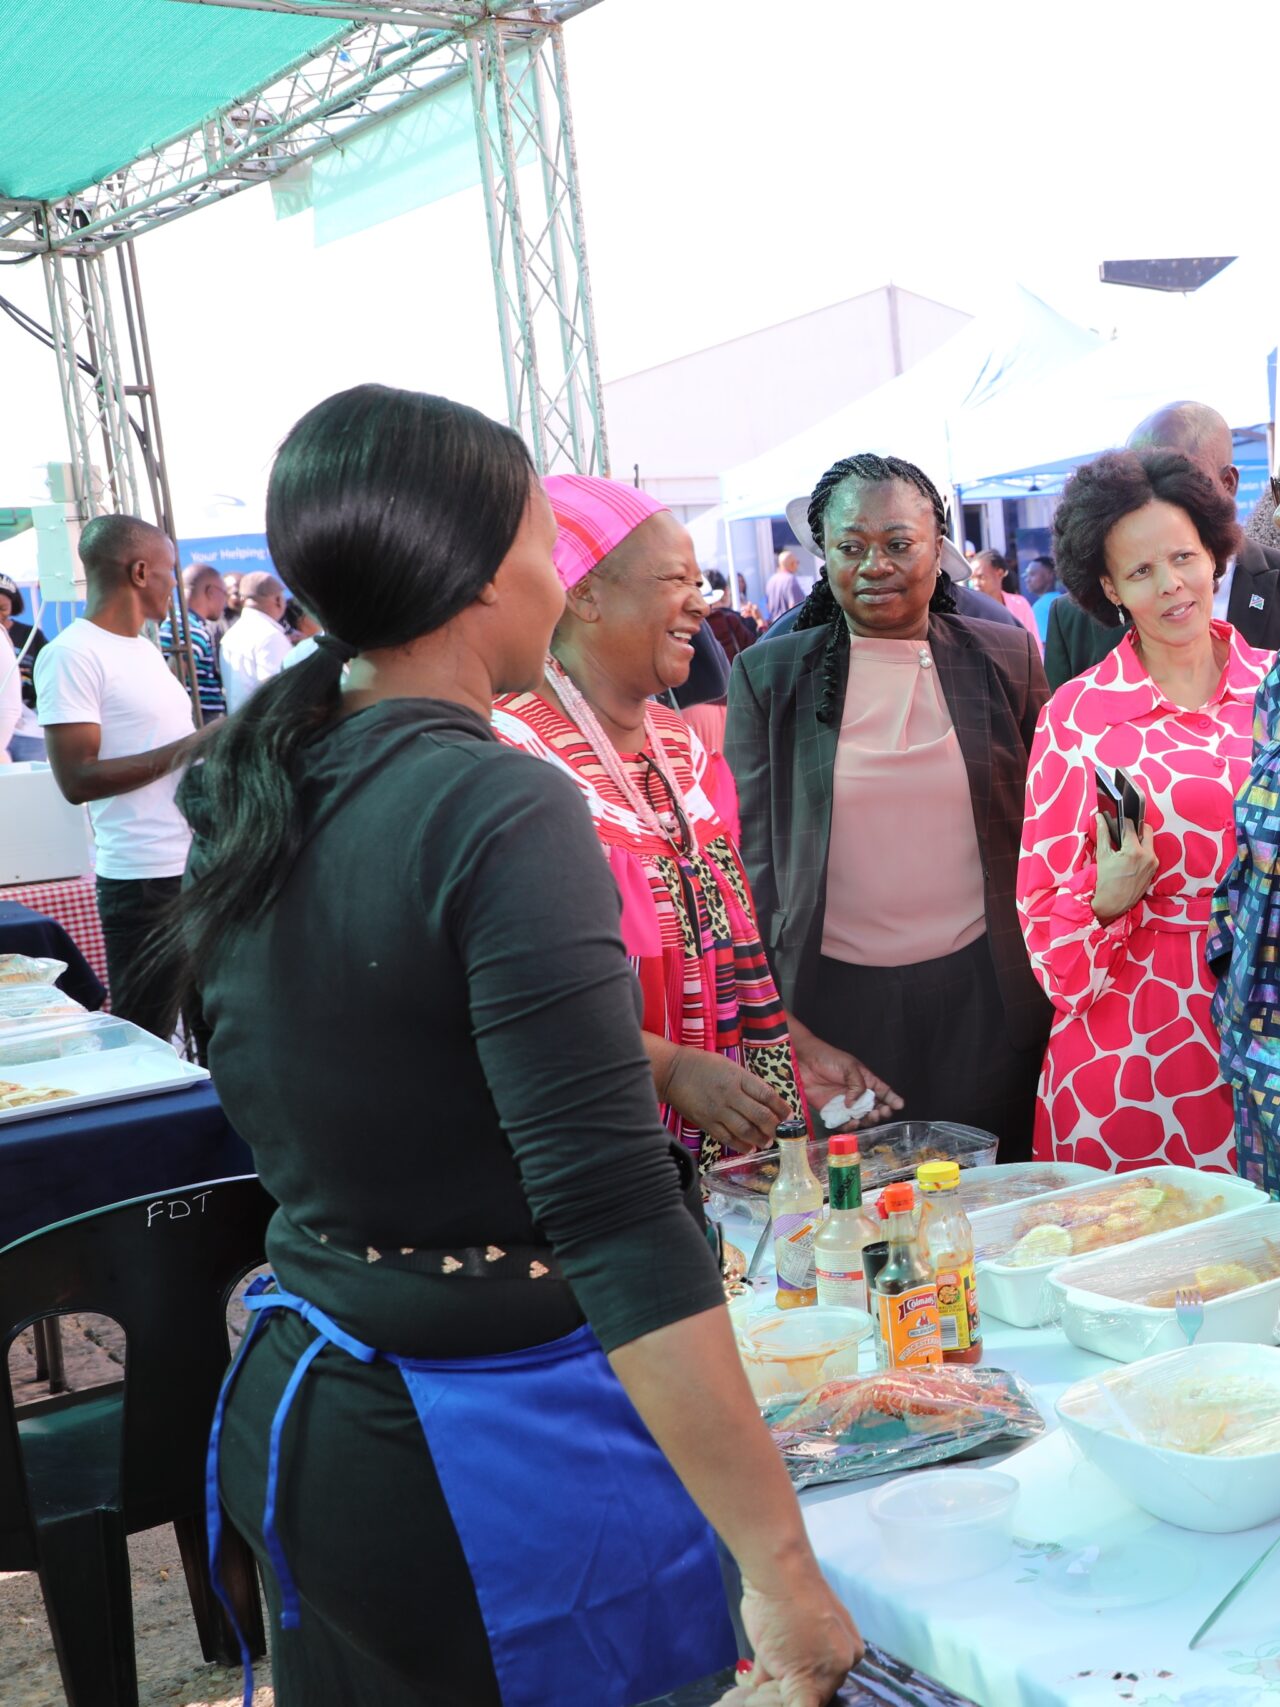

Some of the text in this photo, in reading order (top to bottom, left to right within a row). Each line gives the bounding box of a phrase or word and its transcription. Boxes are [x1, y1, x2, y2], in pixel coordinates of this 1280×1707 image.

[191, 552, 218, 562] Your
[220, 547, 266, 561] Helping
[147, 1190, 213, 1227] FDT
